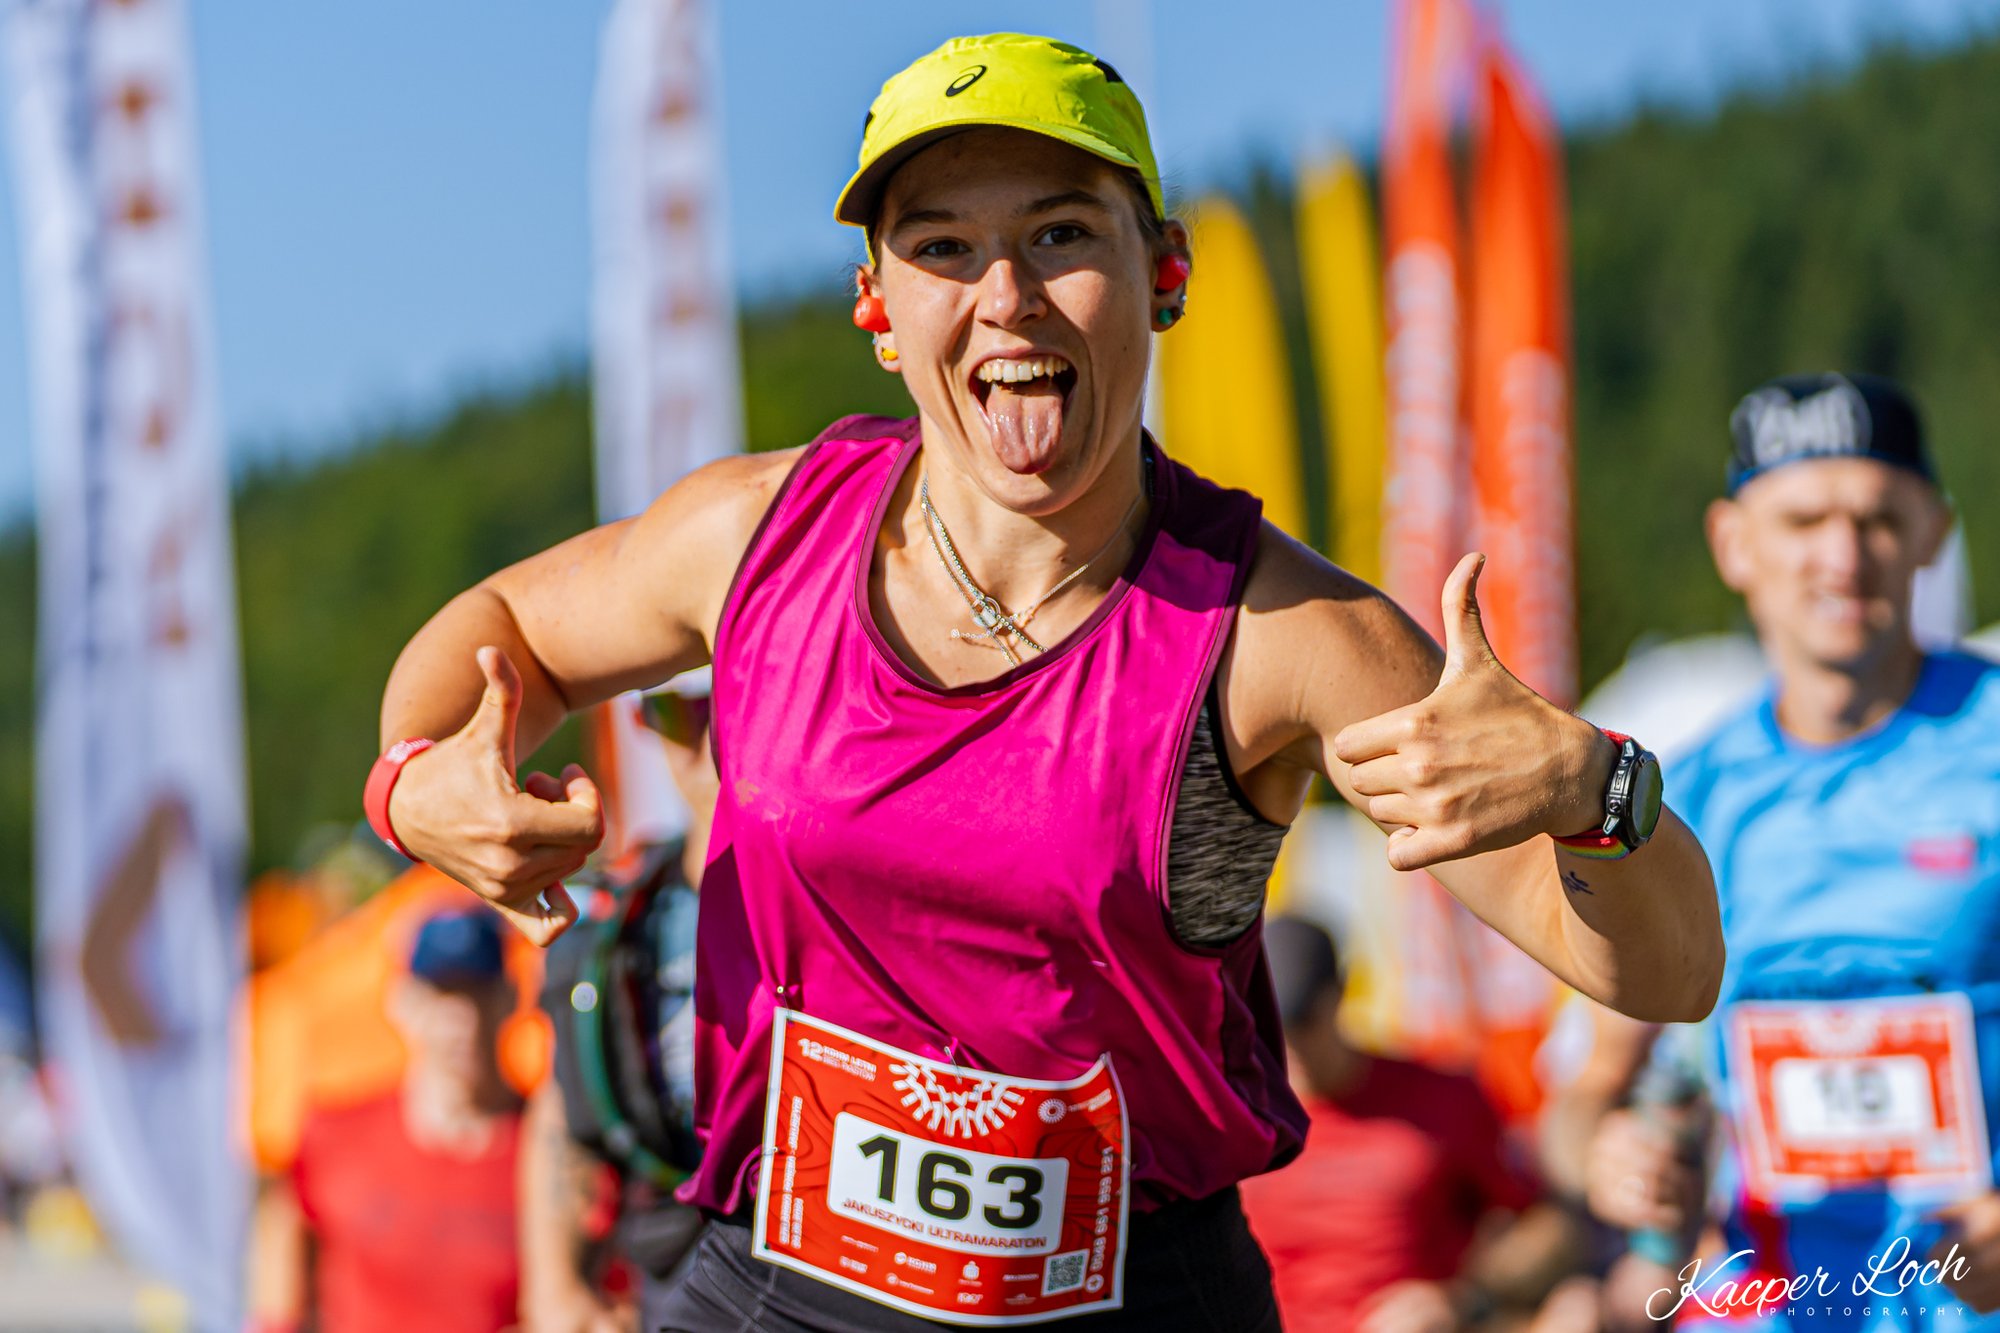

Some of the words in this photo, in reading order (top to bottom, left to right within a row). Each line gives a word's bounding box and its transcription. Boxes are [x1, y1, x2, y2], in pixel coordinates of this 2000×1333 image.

[798, 1038, 823, 1062] 12
[857, 1133, 1044, 1229] 163
[843, 1198, 924, 1233] JAKUSZYCKI
[928, 1225, 1047, 1248] ULTRAMARATON
